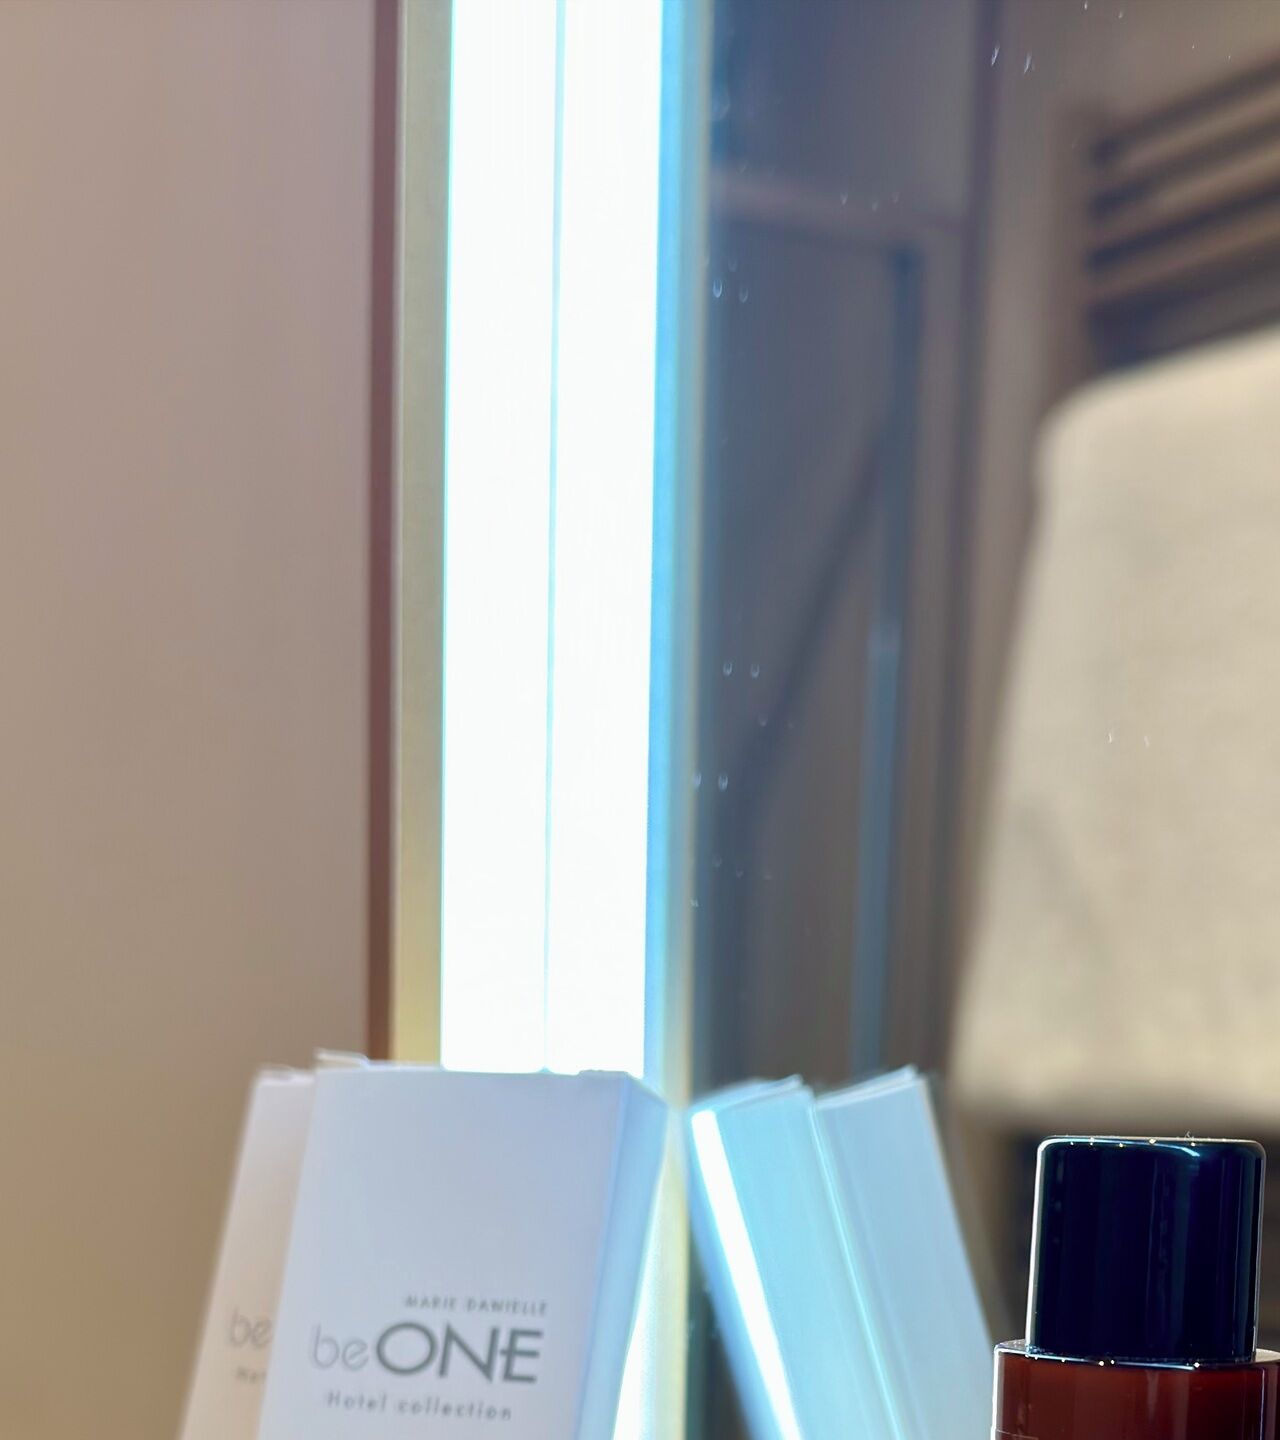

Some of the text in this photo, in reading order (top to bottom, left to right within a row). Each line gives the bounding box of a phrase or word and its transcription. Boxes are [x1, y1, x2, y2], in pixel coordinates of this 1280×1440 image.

[404, 1295, 547, 1317] MARIE DANIELLE
[326, 1390, 512, 1421] Hotel collection
